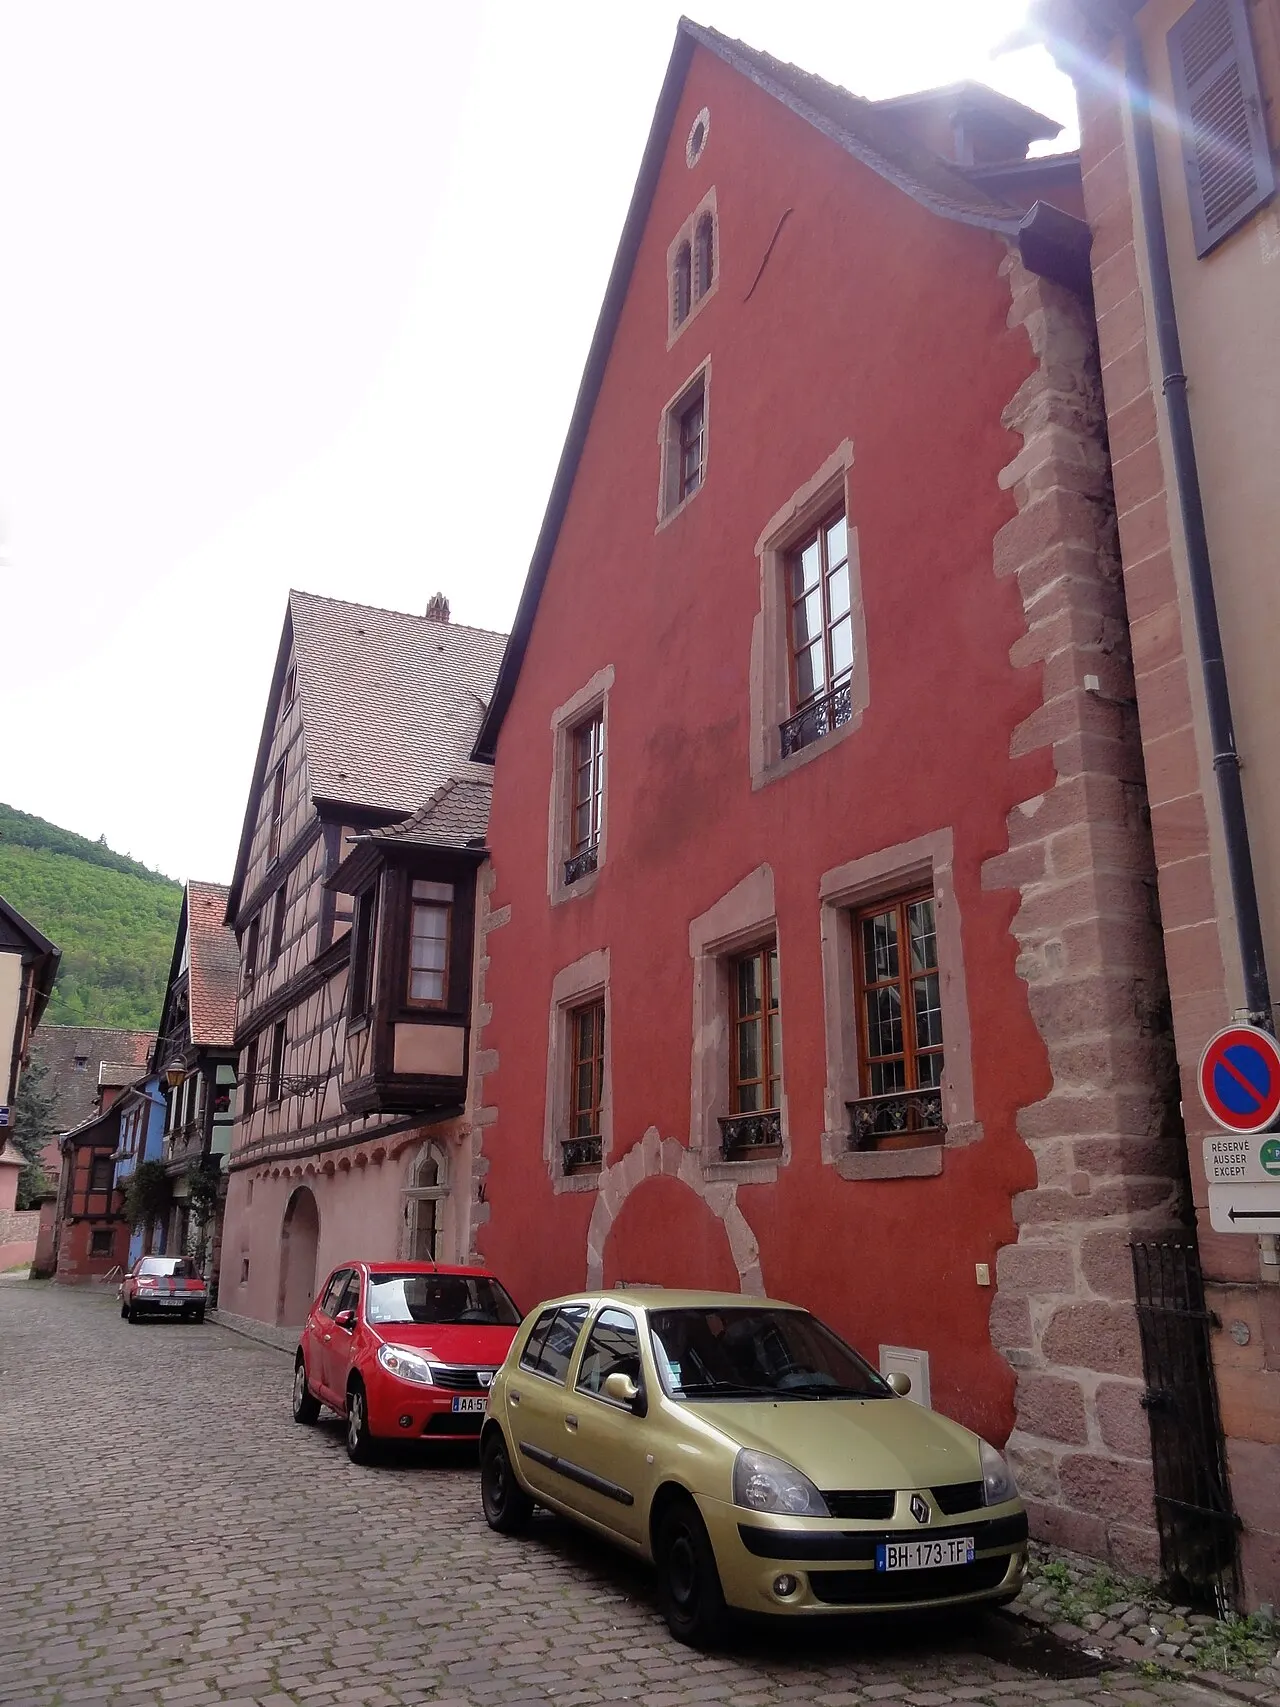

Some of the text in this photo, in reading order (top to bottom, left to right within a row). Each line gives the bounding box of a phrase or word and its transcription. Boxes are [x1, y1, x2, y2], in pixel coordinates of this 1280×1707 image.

[1212, 1140, 1250, 1152] RÉSERVÉ
[1213, 1154, 1247, 1165] AUSSER
[1214, 1166, 1246, 1177] EXCEPT
[888, 1541, 965, 1569] BH-173-TF
